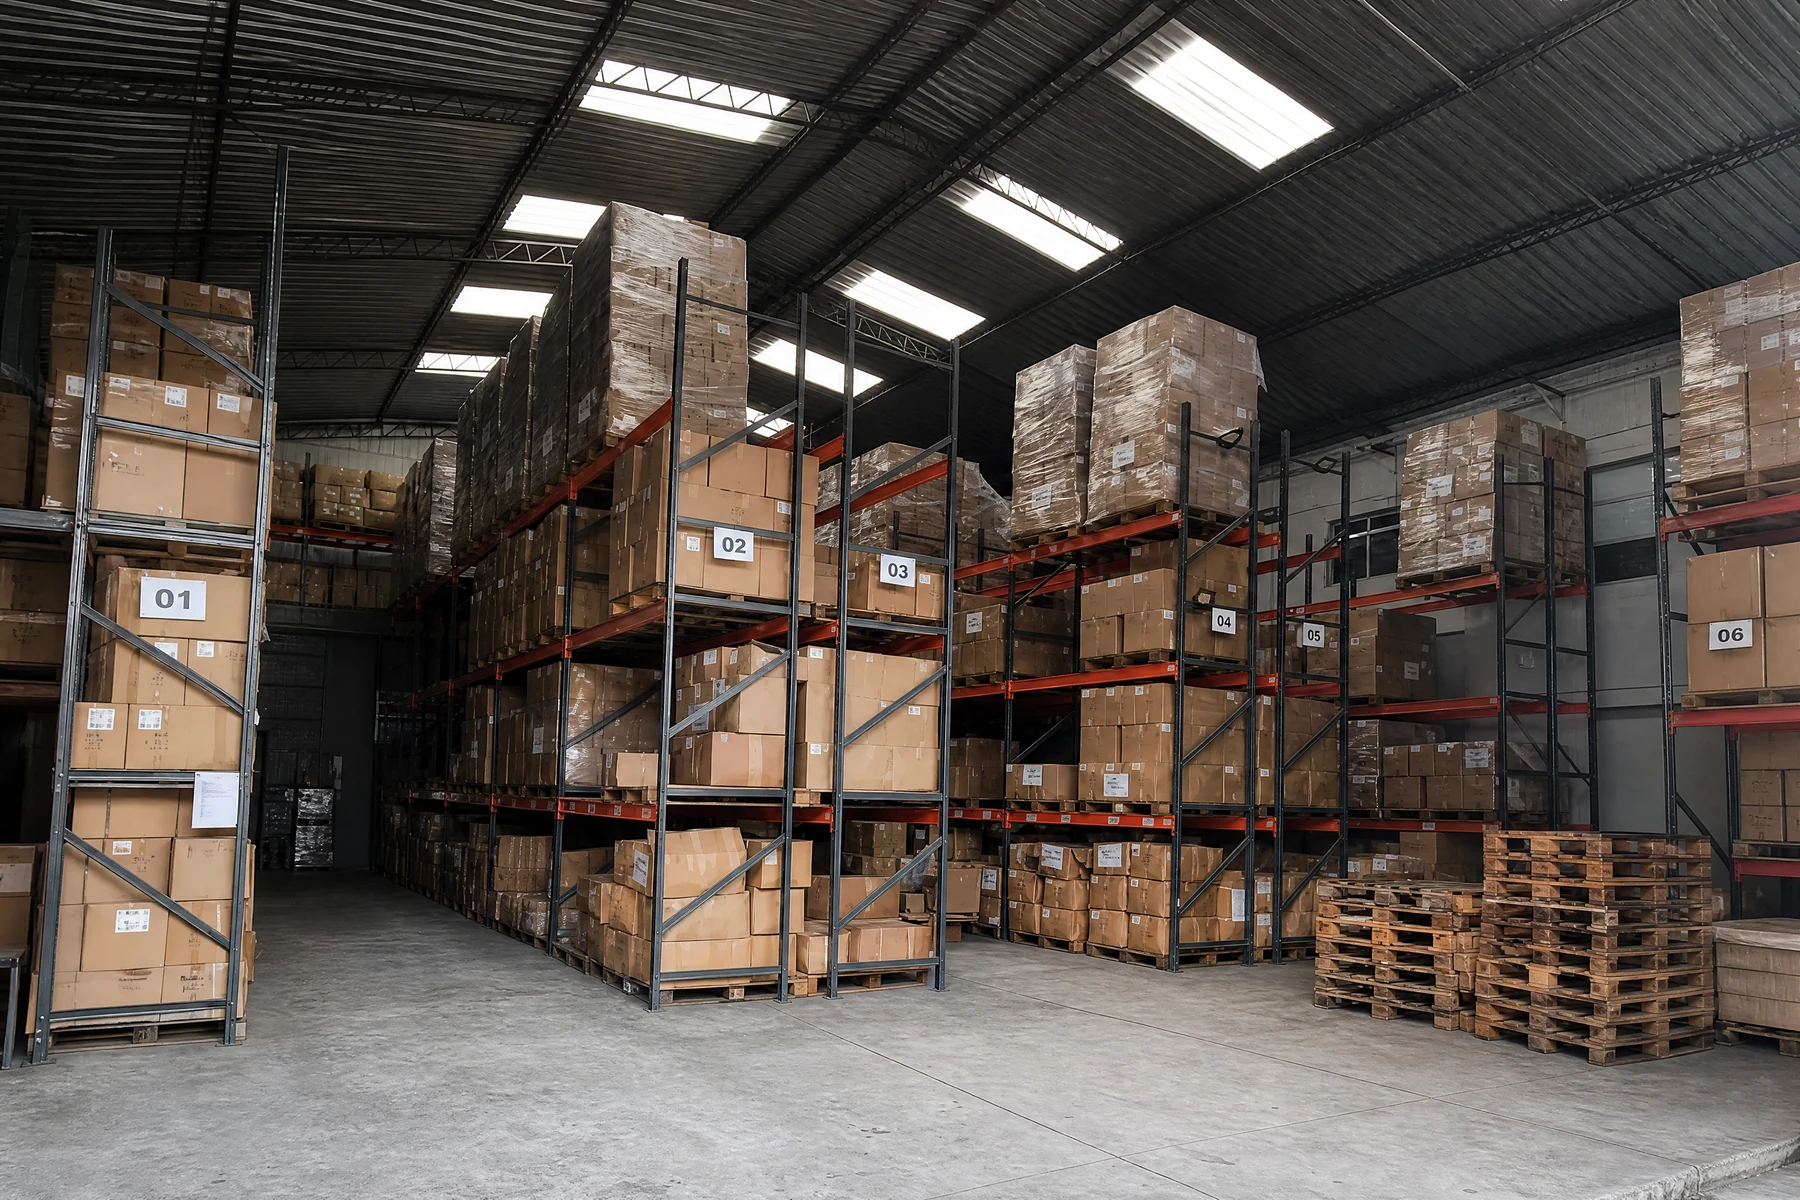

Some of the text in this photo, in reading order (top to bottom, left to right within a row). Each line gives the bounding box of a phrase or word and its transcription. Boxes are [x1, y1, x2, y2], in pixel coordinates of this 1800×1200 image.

[722, 536, 746, 554] 02
[888, 562, 908, 579] 03
[155, 589, 190, 609] 01
[1217, 615, 1231, 628] 04
[1307, 629, 1321, 642] 05
[1717, 627, 1744, 643] 06
